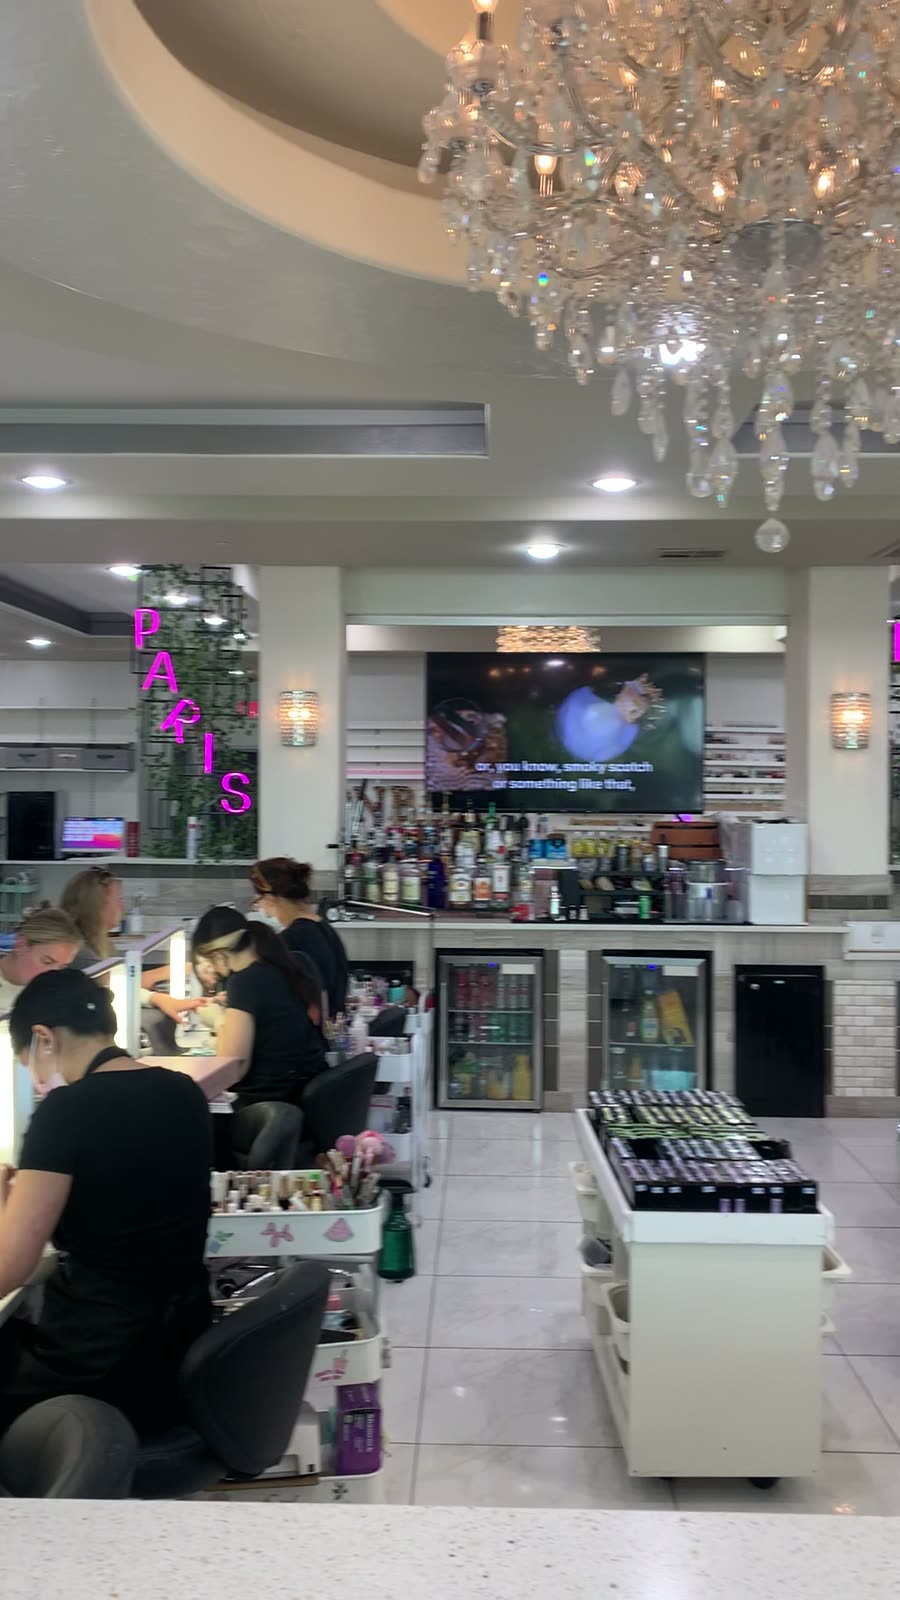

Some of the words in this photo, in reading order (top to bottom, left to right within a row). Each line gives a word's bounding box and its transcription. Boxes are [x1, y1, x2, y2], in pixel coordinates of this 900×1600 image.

[134, 608, 252, 814] PARIS
[475, 763, 495, 773] or,
[496, 763, 521, 774] you
[521, 761, 562, 774] know,
[563, 761, 607, 774] smoky
[607, 761, 654, 773] scotch
[492, 780, 507, 789] or
[508, 778, 578, 792] something
[578, 779, 603, 790] like
[604, 779, 636, 791] that,
